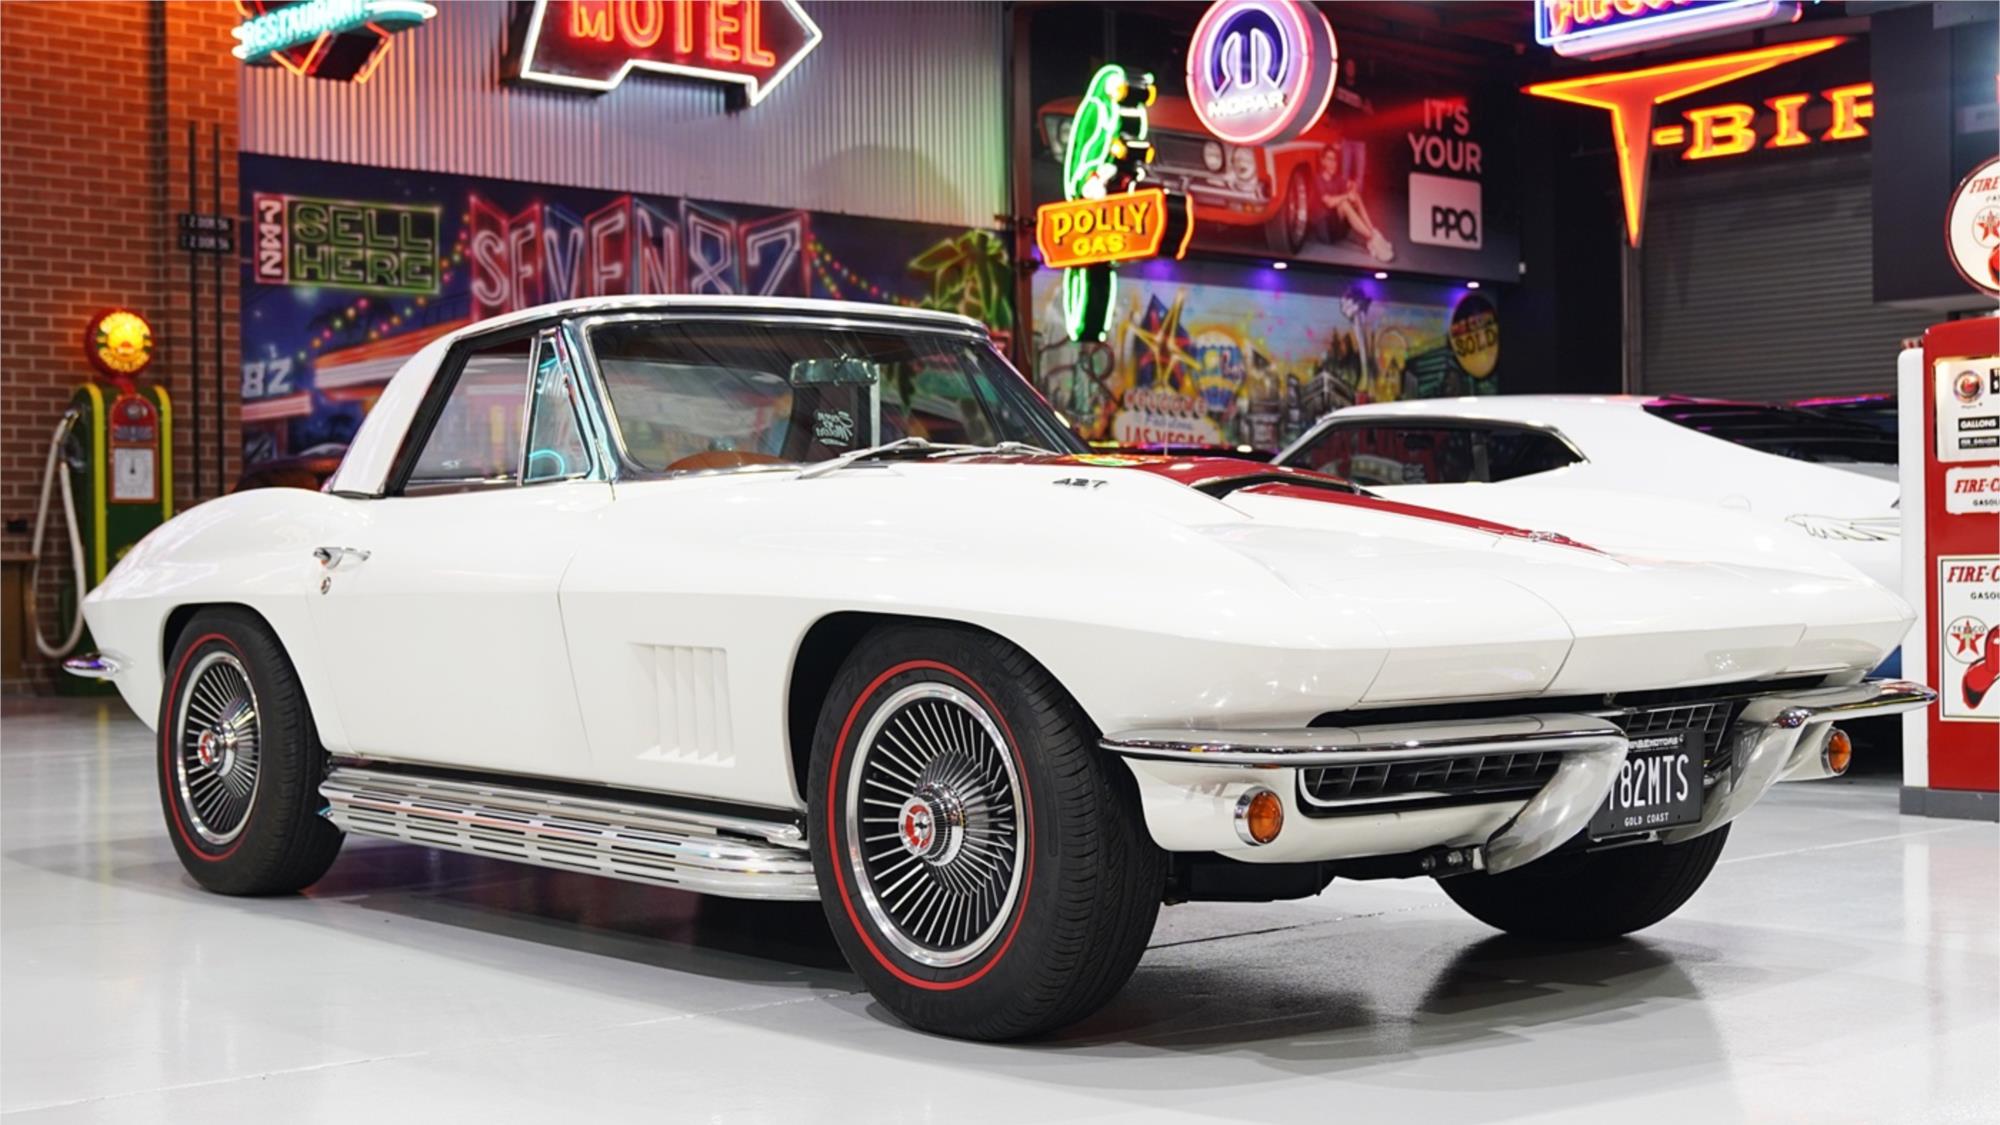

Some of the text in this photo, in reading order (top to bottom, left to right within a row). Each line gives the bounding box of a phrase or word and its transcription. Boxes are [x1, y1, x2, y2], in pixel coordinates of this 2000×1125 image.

[570, 0, 776, 68] MOTEL
[1206, 90, 1286, 118] MOPAR
[1424, 98, 1470, 136] IT'S
[1407, 132, 1482, 174] YOUR
[294, 203, 434, 250] SELL
[1051, 202, 1149, 244] POLLY
[1431, 205, 1478, 243] PPQ
[1072, 232, 1125, 256] GAS
[294, 243, 434, 290] HERE
[1454, 328, 1497, 357] SOLD
[1052, 477, 1108, 489] 427
[1624, 811, 1669, 827] GOLD COAST
